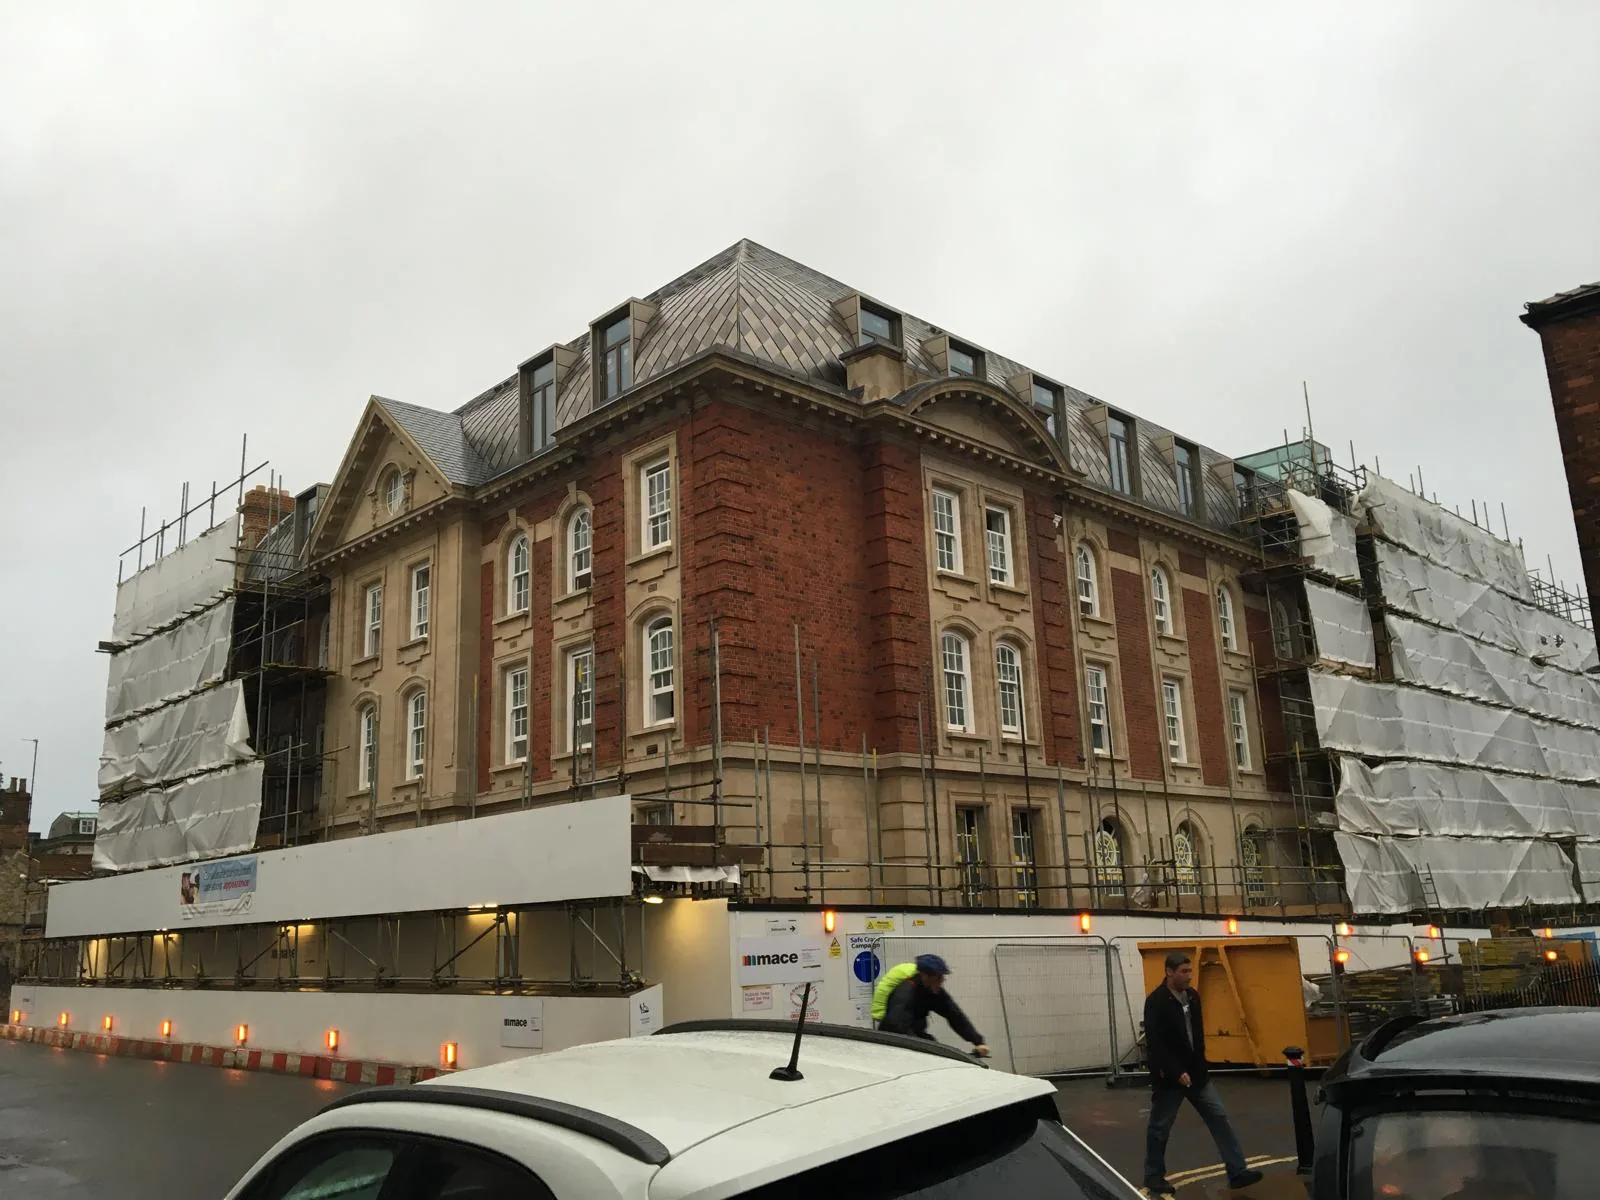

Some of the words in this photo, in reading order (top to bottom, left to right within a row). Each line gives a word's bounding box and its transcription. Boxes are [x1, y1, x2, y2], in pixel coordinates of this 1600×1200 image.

[850, 936, 863, 944] Safe
[757, 952, 799, 966] mace
[509, 1018, 527, 1028] mace
